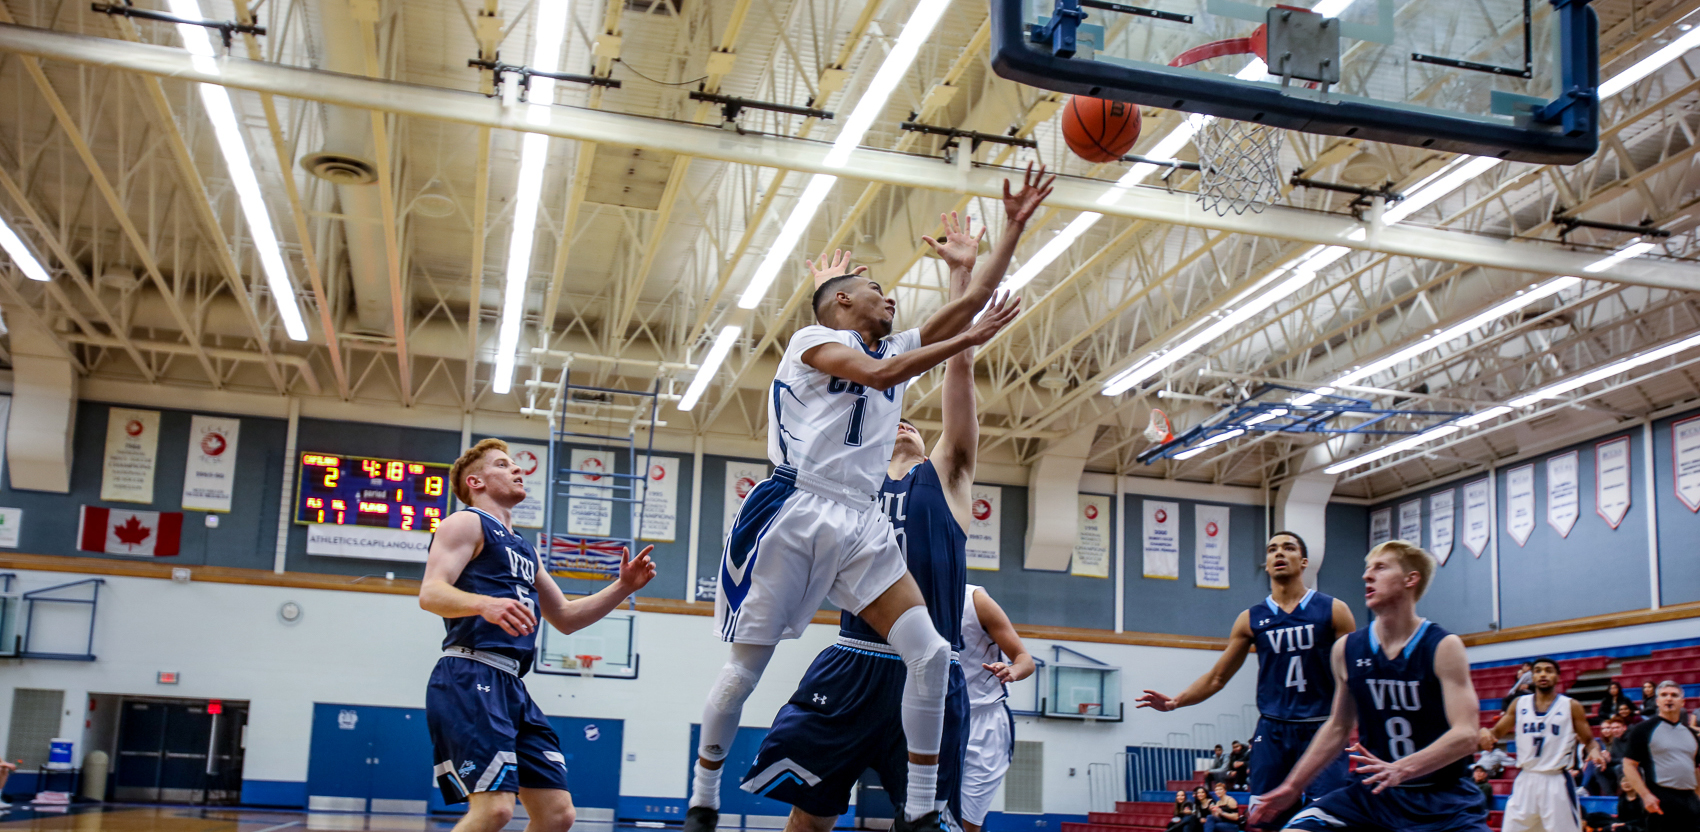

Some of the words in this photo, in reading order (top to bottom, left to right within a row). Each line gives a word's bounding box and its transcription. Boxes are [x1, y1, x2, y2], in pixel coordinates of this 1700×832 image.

[844, 394, 869, 447] 1
[303, 454, 340, 467] CAPILANO
[362, 460, 405, 481] 4:18
[324, 466, 340, 488] 2
[424, 475, 444, 497] 13
[396, 488, 404, 503] 1
[306, 497, 325, 509] FLS
[359, 501, 390, 514] PLAYER
[424, 506, 441, 518] FLS
[317, 509, 326, 524] 1
[337, 511, 346, 525] 1
[401, 515, 415, 531] 2
[310, 535, 429, 550] ATHLETICS.CAPILANOU.CA
[504, 546, 536, 586] VIU
[1266, 624, 1316, 654] VIU
[1285, 655, 1308, 693] 4
[1365, 678, 1422, 712] VIU
[1385, 716, 1416, 762] 8
[1522, 722, 1546, 734] CAP
[1551, 723, 1561, 736] U
[1532, 736, 1546, 758] 7
